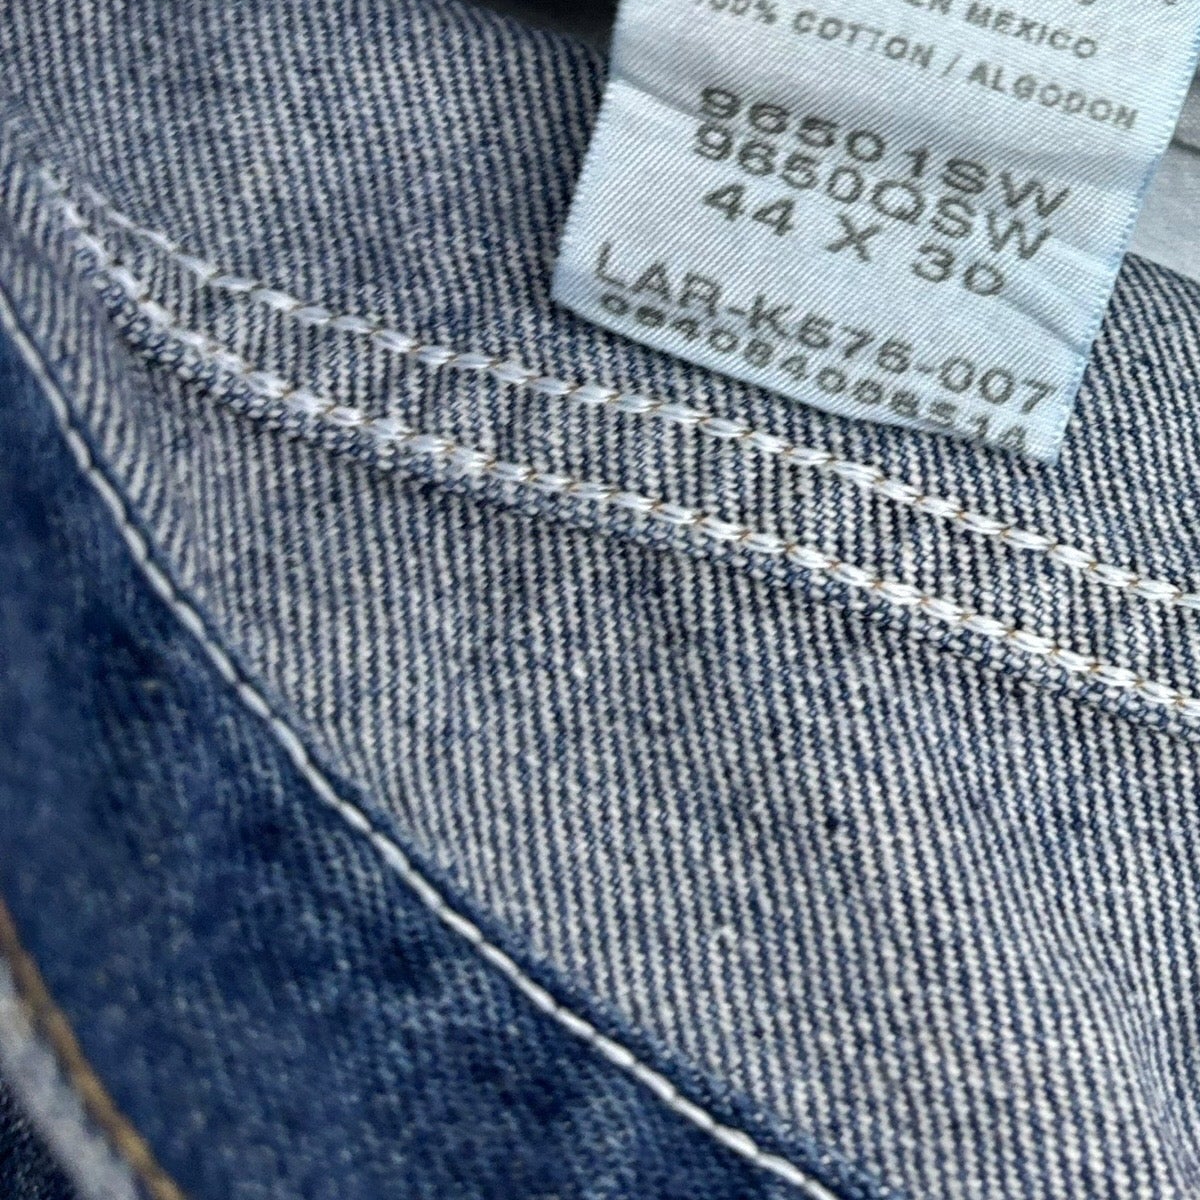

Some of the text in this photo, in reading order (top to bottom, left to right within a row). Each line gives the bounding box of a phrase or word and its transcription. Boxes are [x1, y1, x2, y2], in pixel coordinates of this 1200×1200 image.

[792, 10, 934, 69] COTTON
[967, 61, 1137, 130] ALGODON
[964, 1, 1097, 59] MEXICO
[693, 120, 1052, 261] 9650QSW
[700, 87, 1070, 219] 96501SW
[701, 182, 1007, 299] 44 X 30
